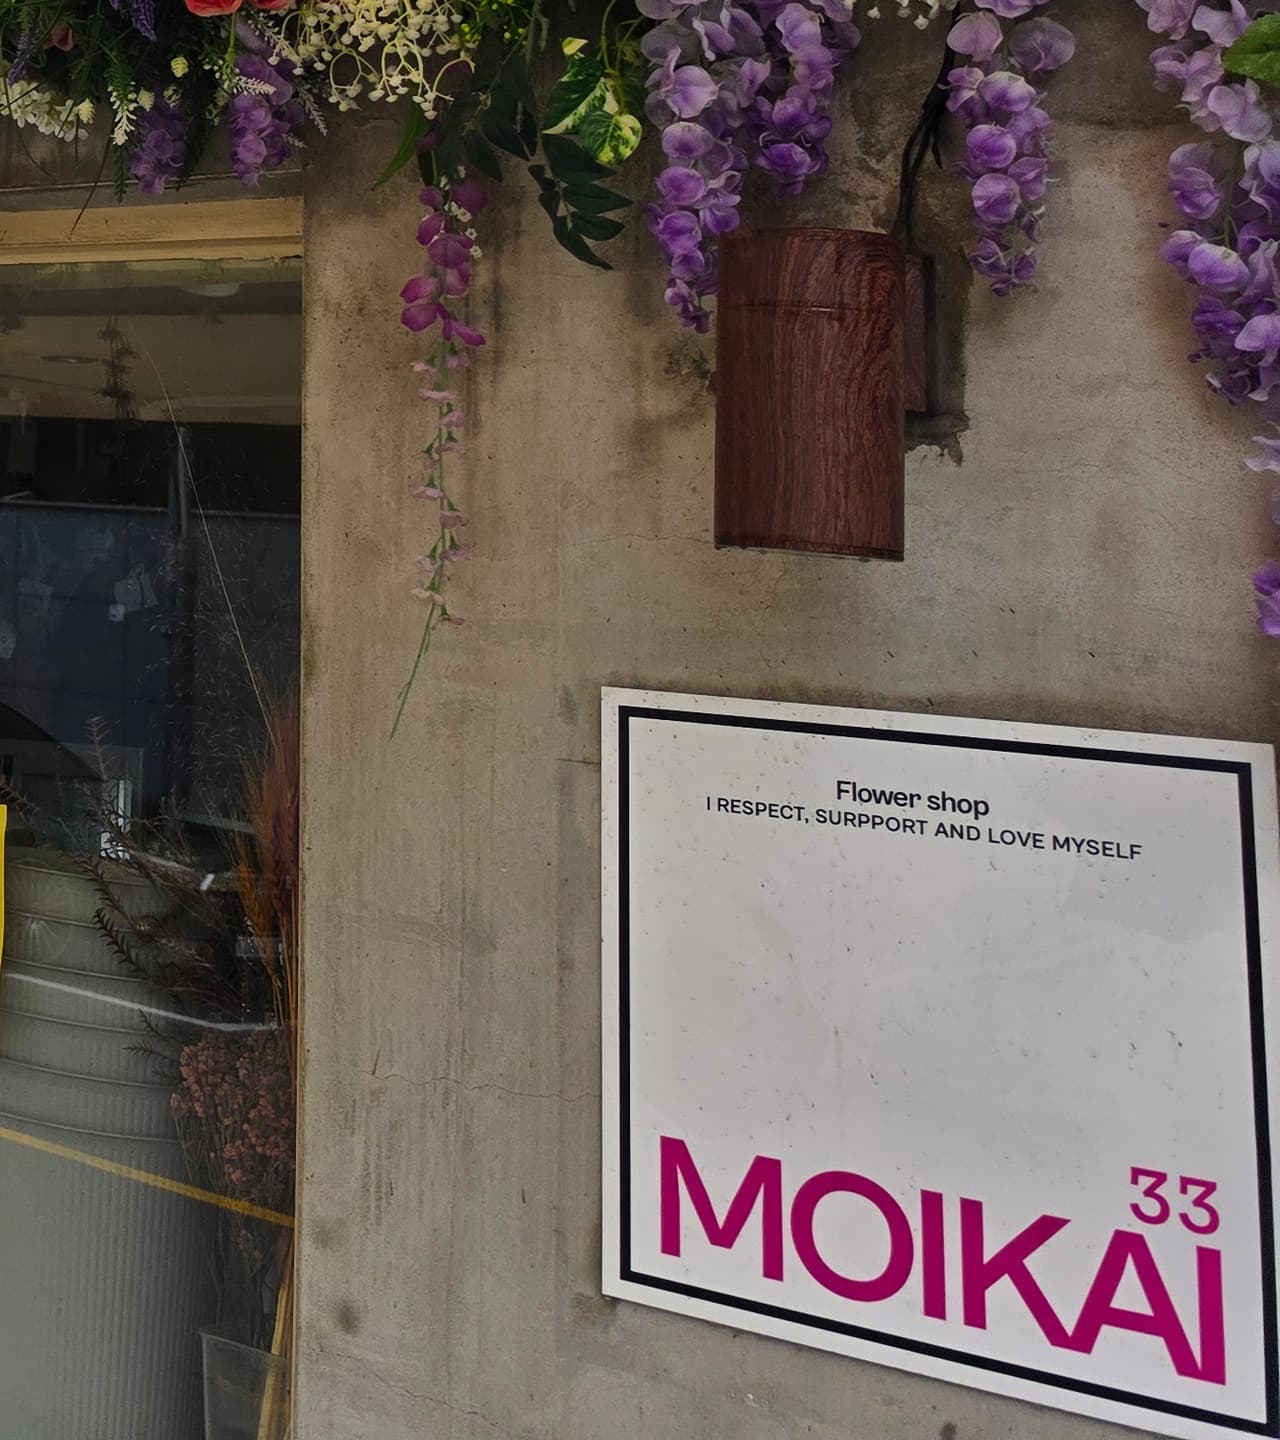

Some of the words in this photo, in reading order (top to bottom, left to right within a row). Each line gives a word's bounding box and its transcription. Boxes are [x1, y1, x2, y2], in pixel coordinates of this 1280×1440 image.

[706, 796, 711, 811] I
[717, 797, 809, 824] RESPECT,
[815, 809, 928, 835] SURPPORT
[934, 822, 981, 842] AND
[988, 827, 1045, 850] LOVE
[1052, 834, 1143, 860] MYSELF
[837, 779, 922, 809] Flower
[927, 790, 989, 820] shop
[1129, 1166, 1221, 1236] 33
[659, 1134, 1226, 1387] MOIKAI
